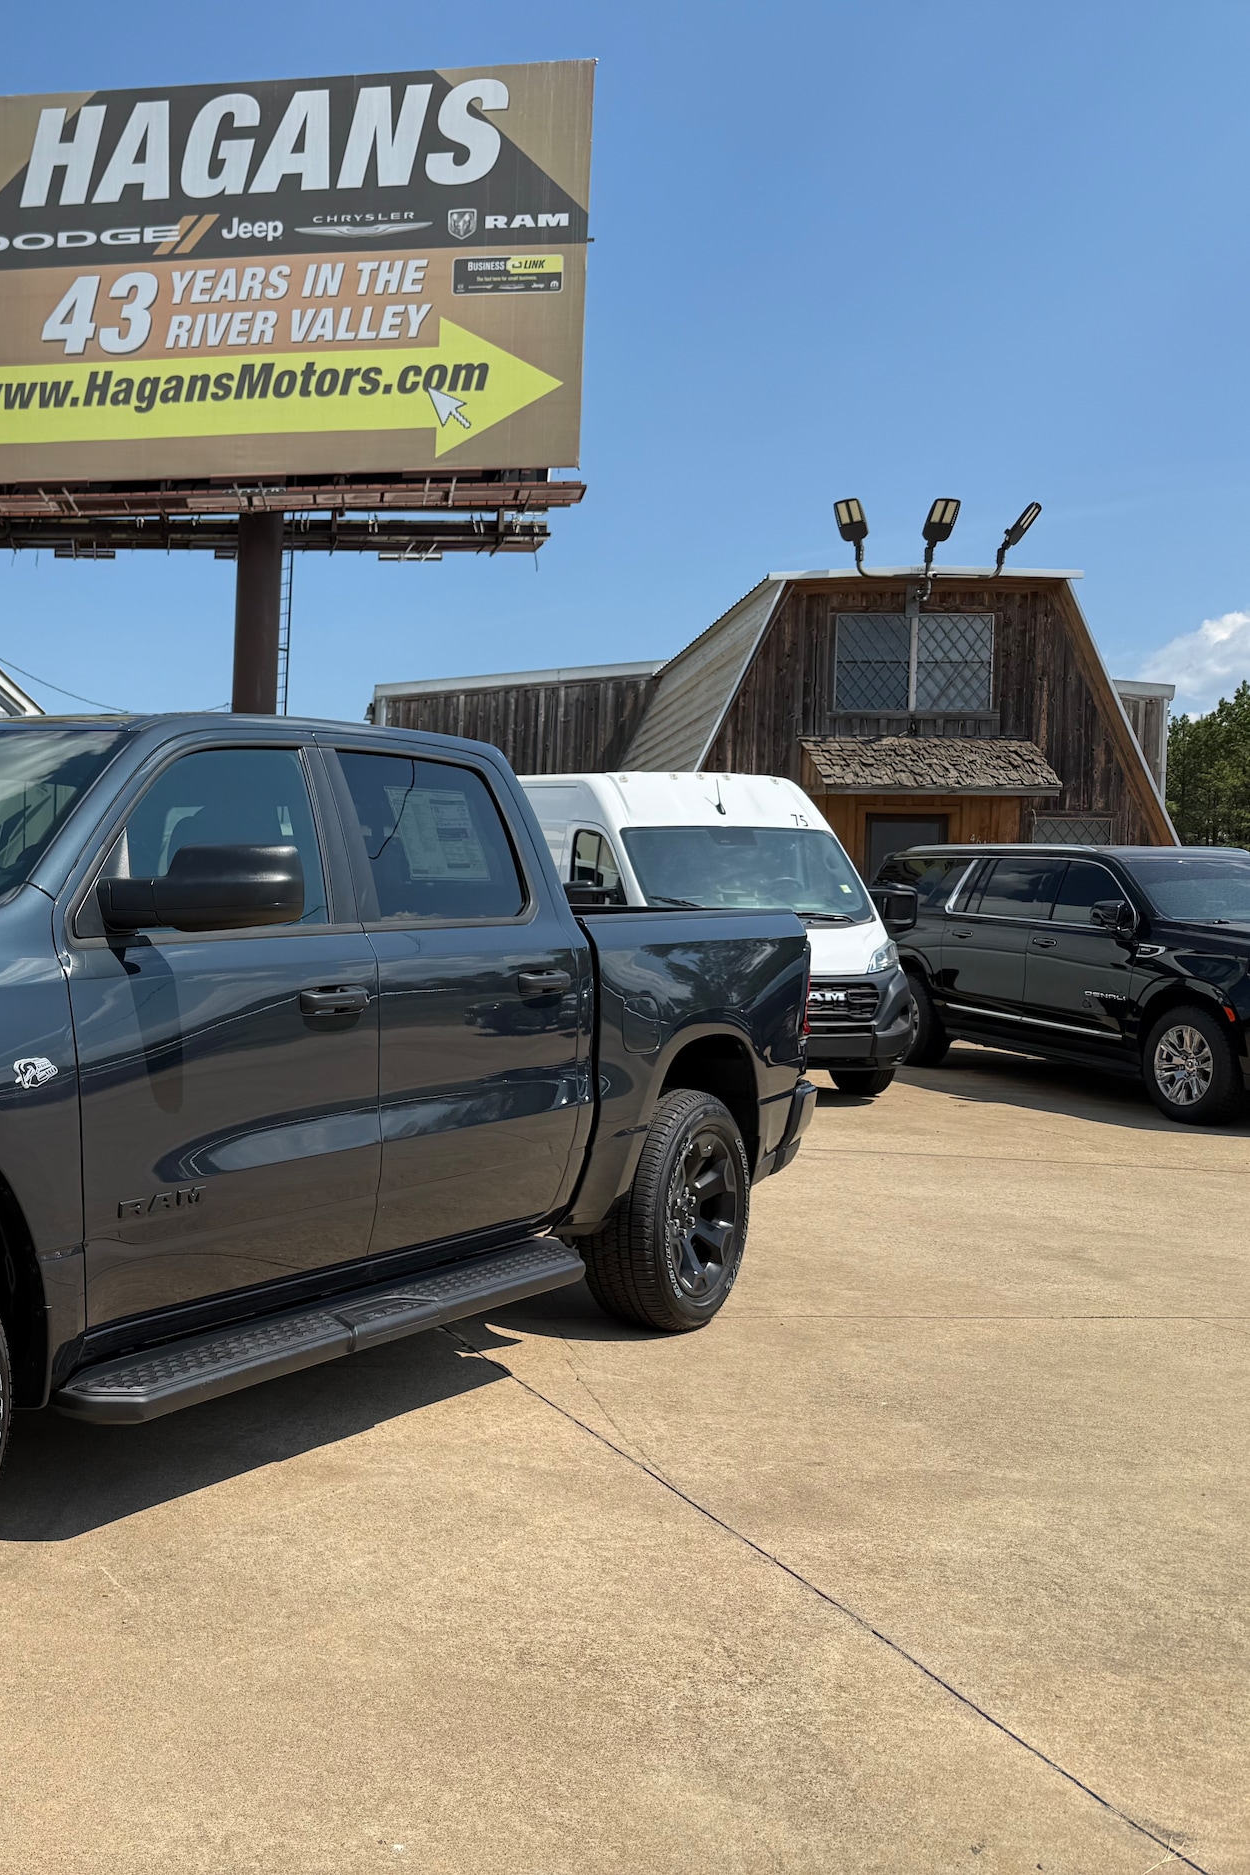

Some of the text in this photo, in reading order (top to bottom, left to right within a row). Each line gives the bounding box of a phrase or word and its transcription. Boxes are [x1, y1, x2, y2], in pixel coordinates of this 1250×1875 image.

[19, 78, 510, 208] HAGANS
[312, 211, 416, 224] CHRYSLER
[484, 212, 570, 229] RAM
[221, 217, 284, 241] Jeep
[467, 259, 546, 271] BUSINESS LINK
[170, 258, 429, 305] YEARS IN THE
[41, 271, 159, 356] 43
[165, 304, 433, 349] RIVER VALLEY
[790, 813, 809, 827] 75
[808, 990, 848, 1002] AM
[1084, 990, 1127, 1001] DENALI
[116, 1185, 207, 1219] RAM
